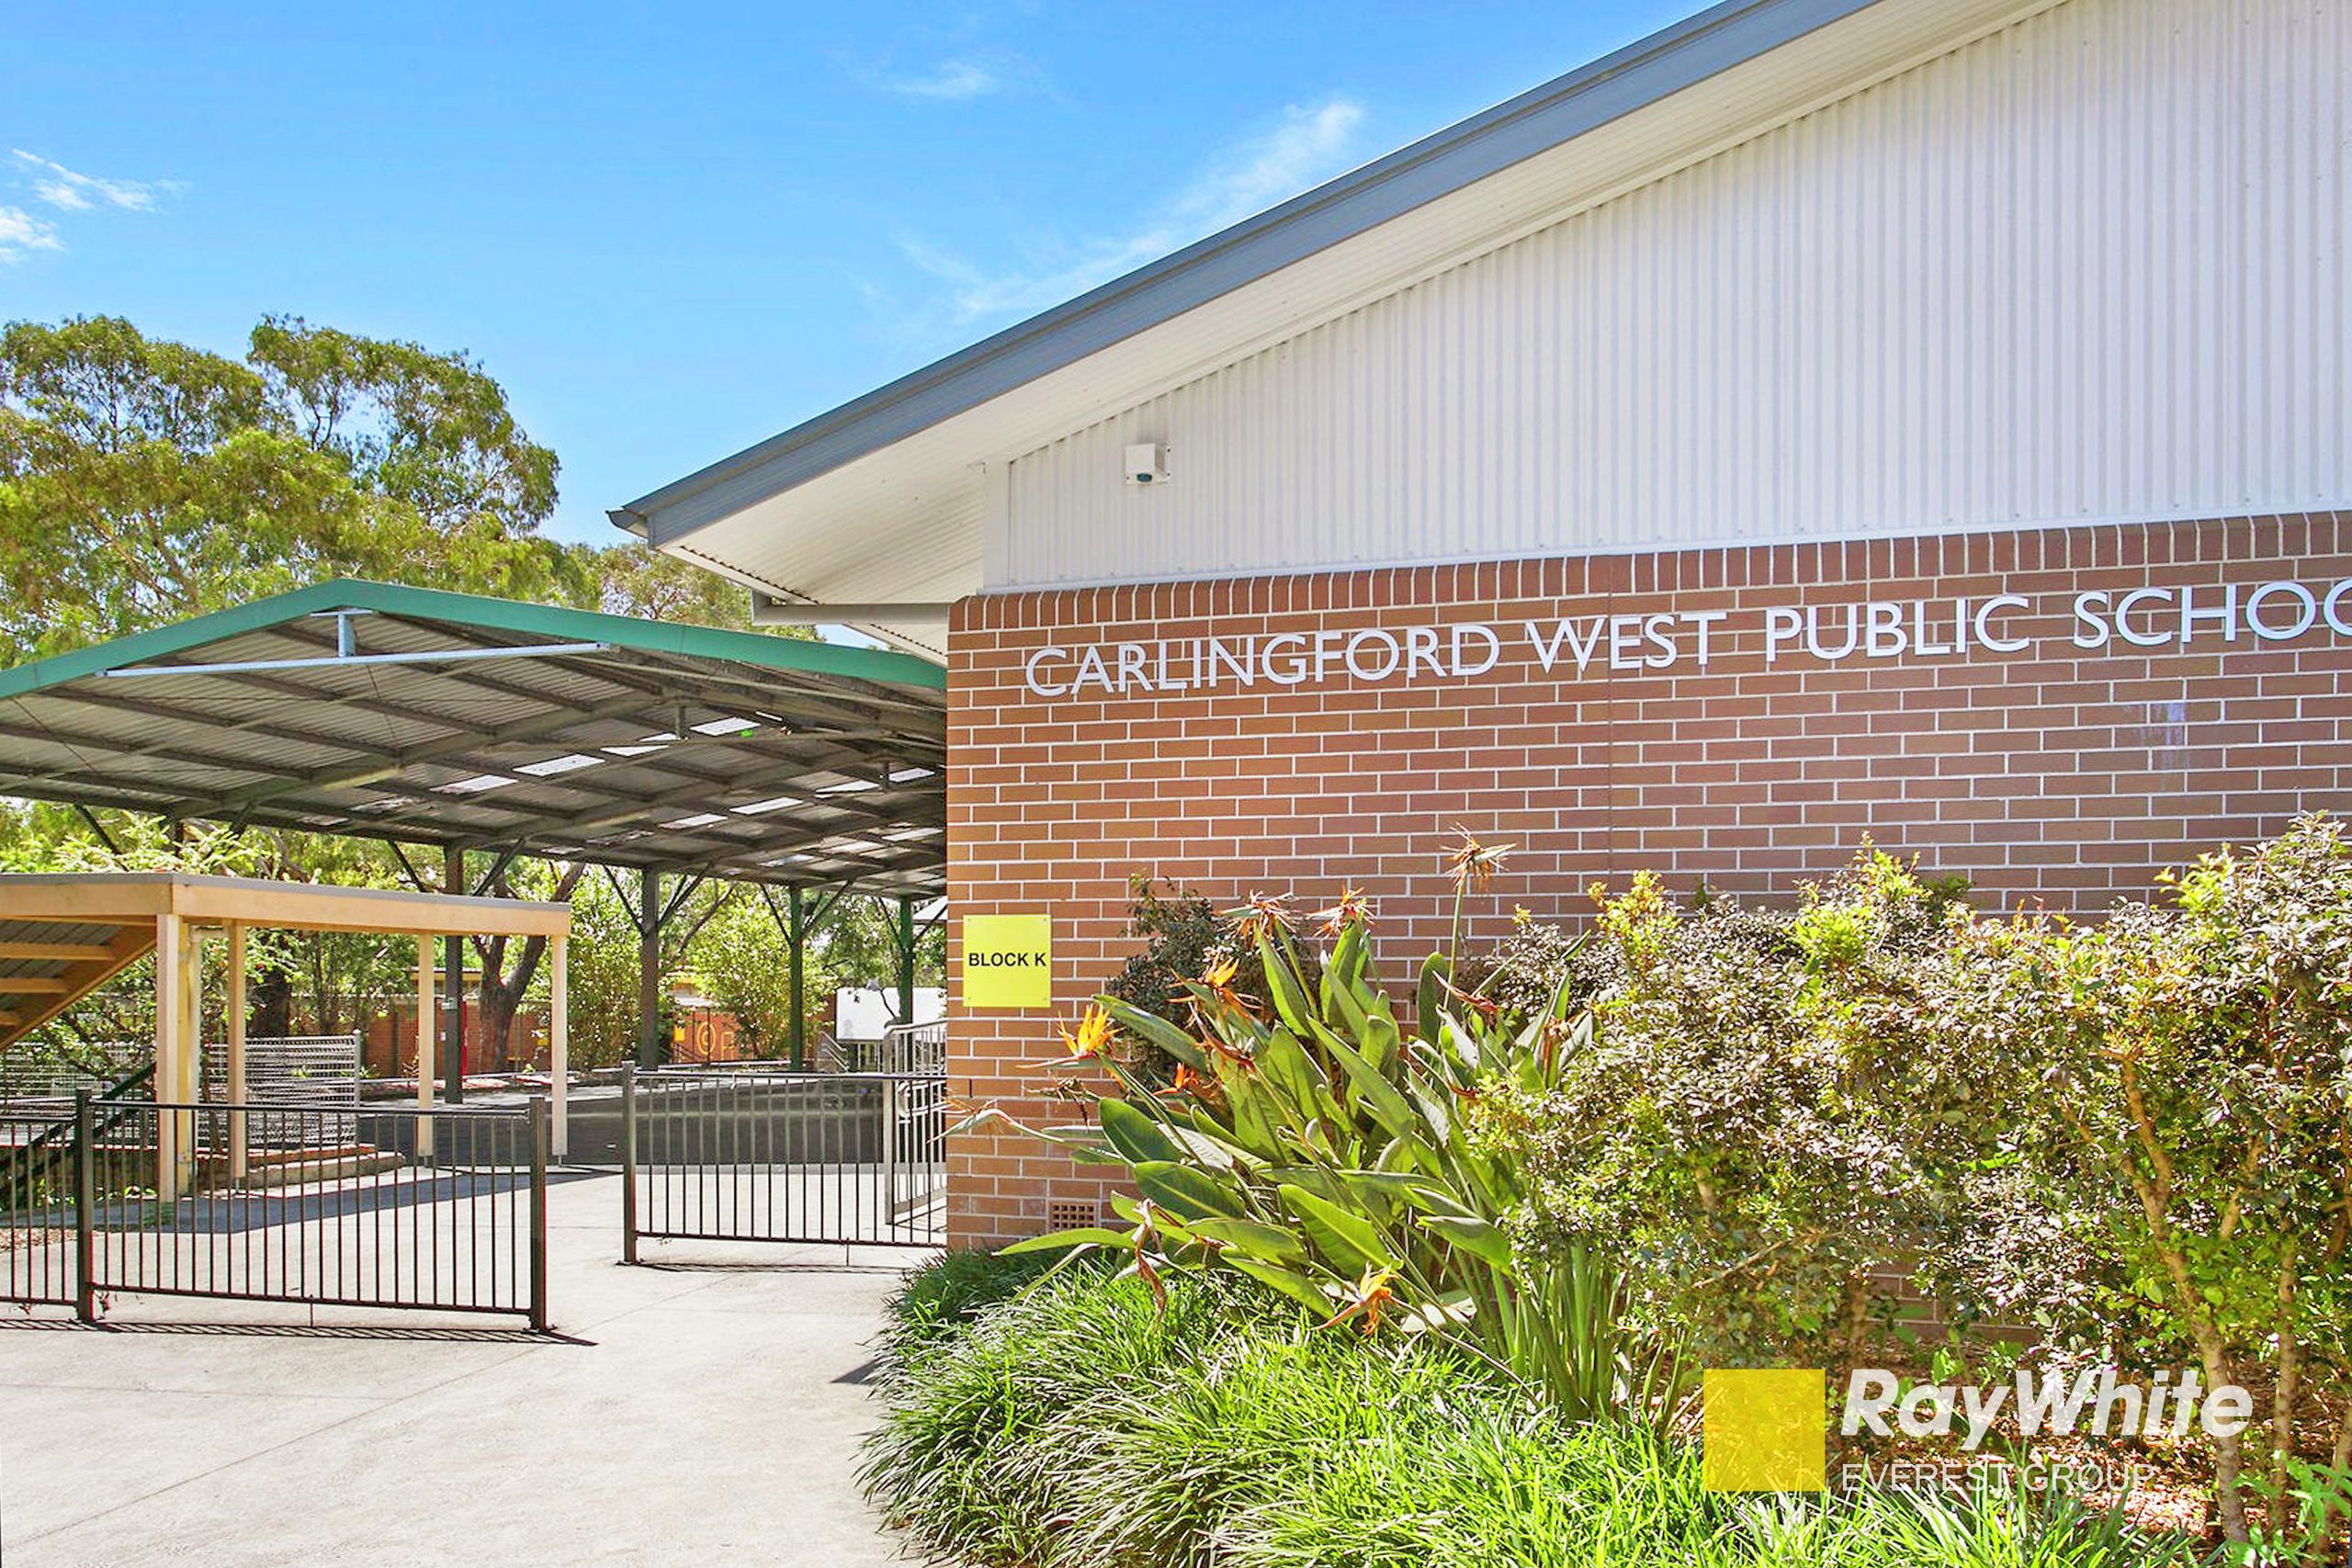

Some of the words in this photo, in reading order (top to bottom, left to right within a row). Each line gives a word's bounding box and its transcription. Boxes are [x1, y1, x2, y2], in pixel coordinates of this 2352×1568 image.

[1025, 624, 1500, 697] CARLINGFORD
[1525, 612, 1727, 673] WEST
[1765, 594, 2030, 662] PUBLIC
[968, 952, 1029, 966] BLOCK
[1035, 952, 1047, 966] K
